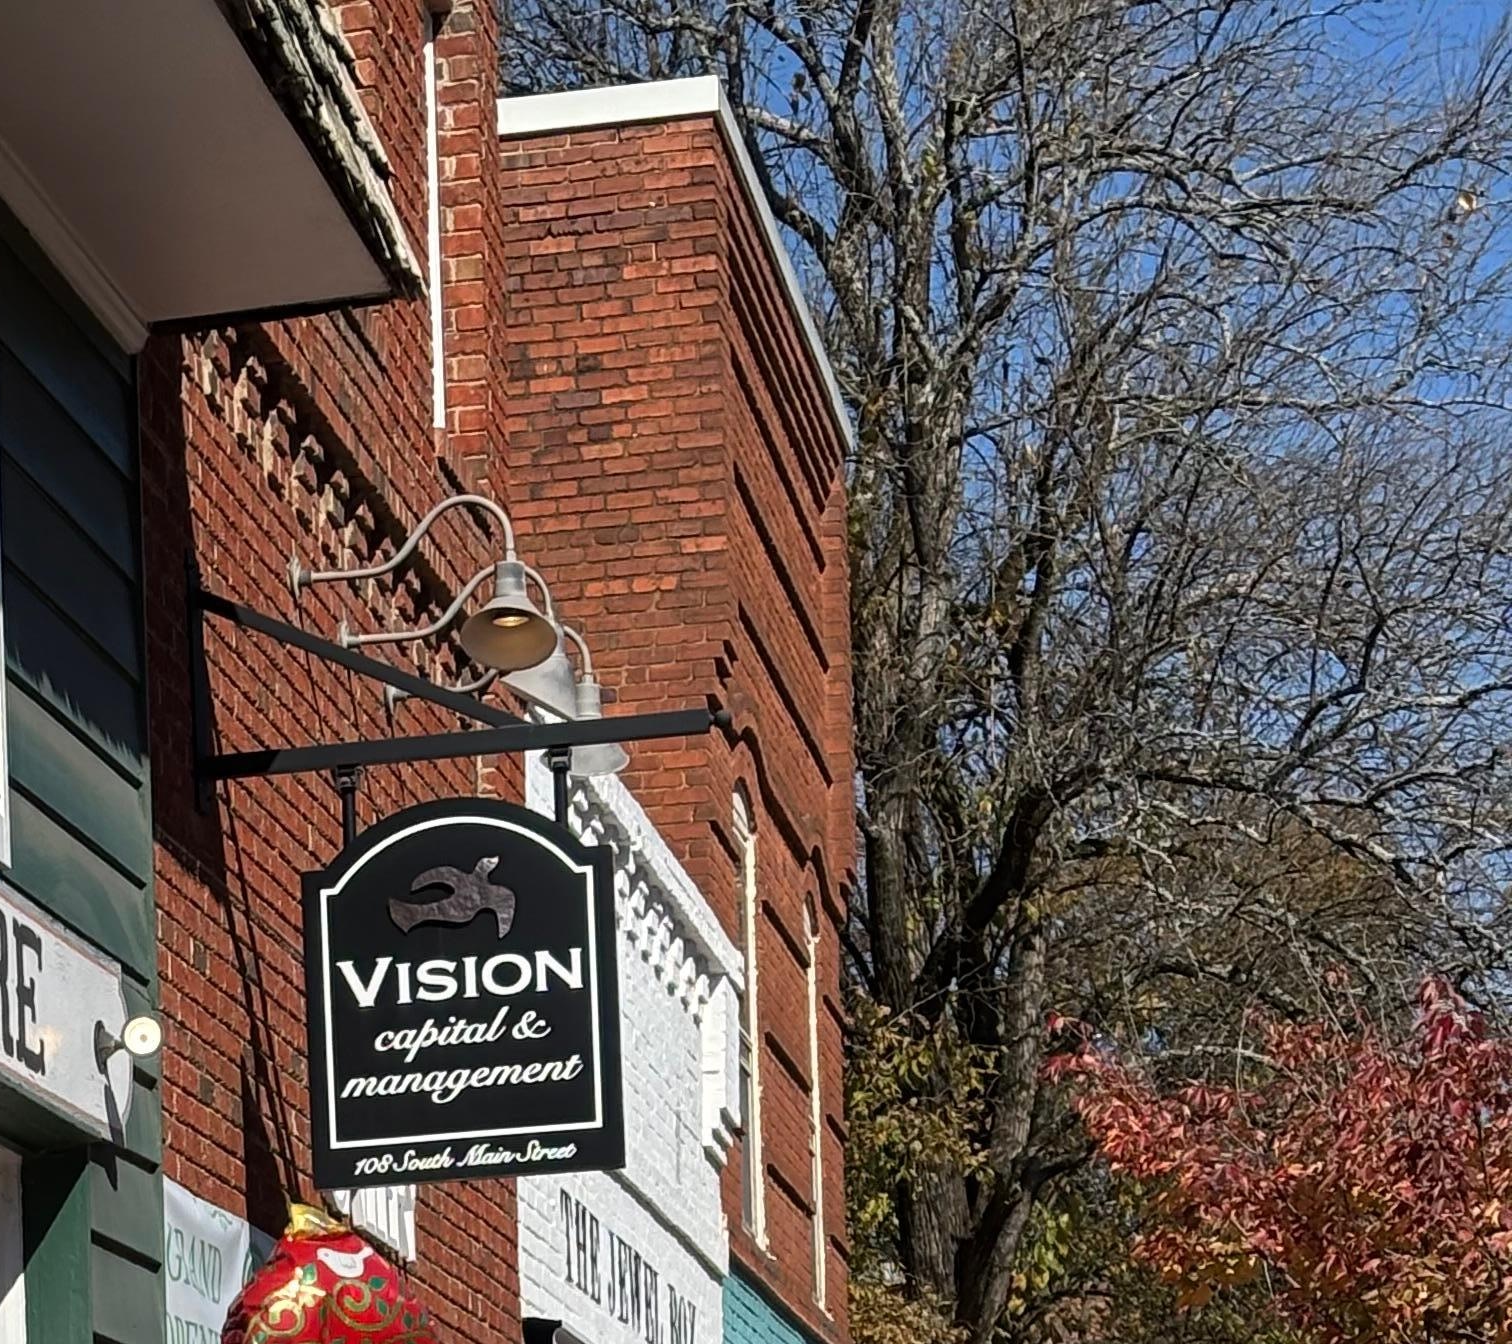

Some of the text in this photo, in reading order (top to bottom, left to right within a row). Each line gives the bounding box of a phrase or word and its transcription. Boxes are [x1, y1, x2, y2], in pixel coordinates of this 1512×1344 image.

[374, 1006, 551, 1063] capital &
[341, 1054, 583, 1104] management
[354, 1140, 578, 1176] 108 South Main Street
[560, 1187, 601, 1305] THE
